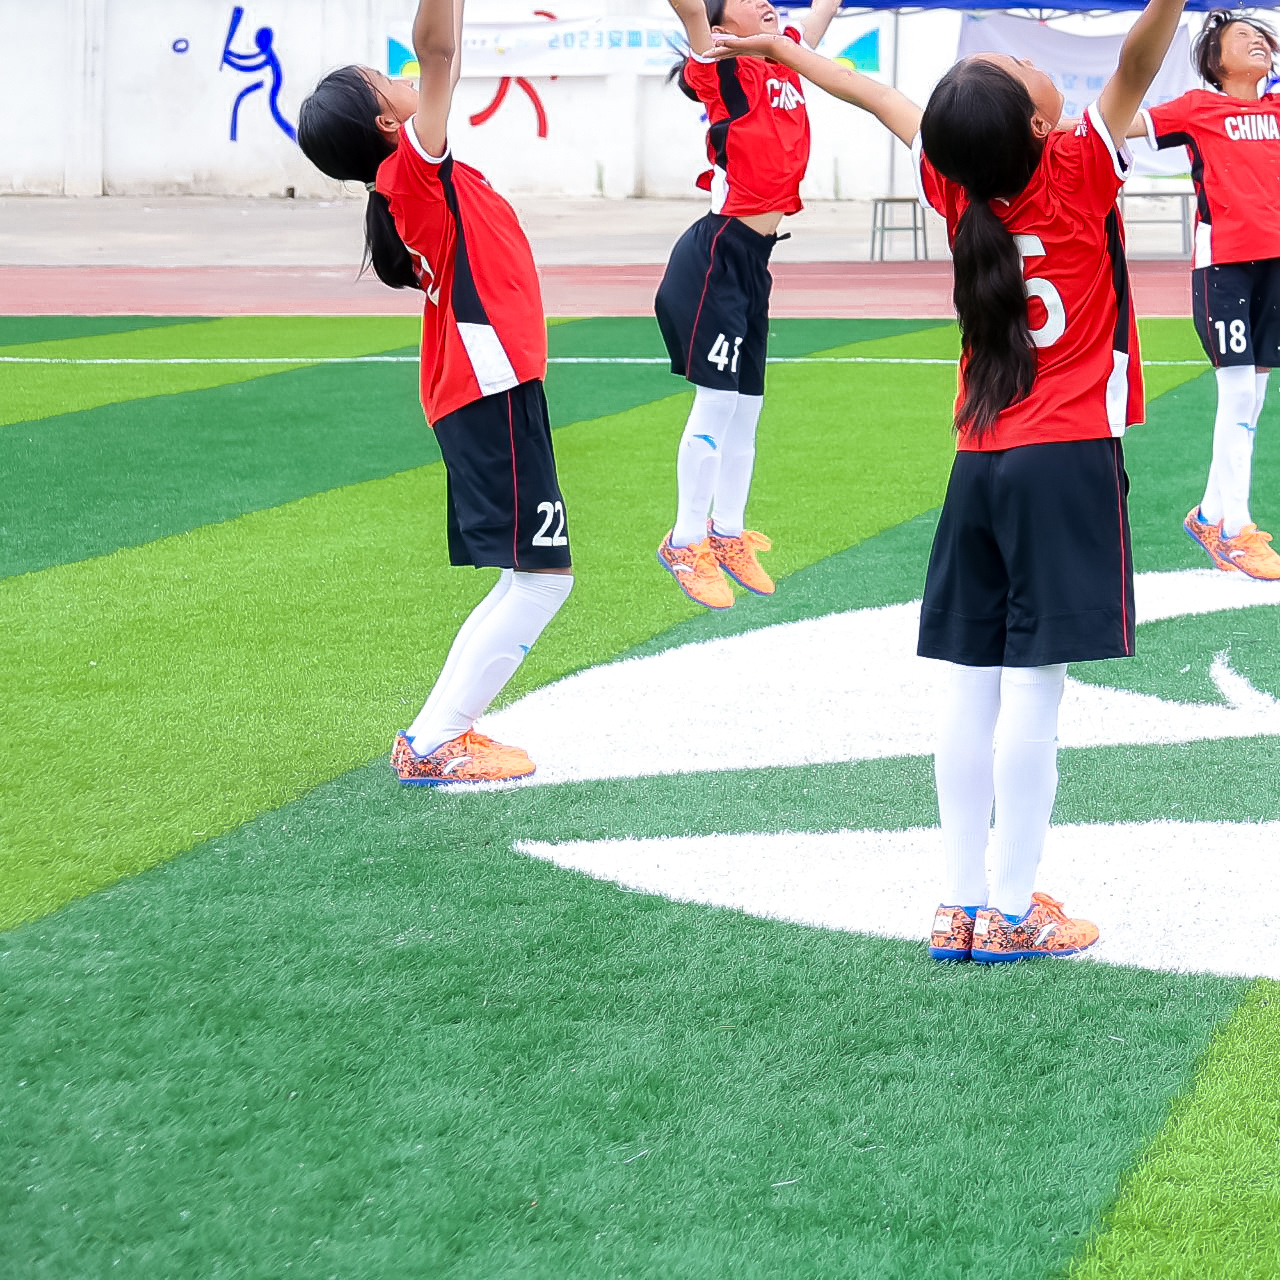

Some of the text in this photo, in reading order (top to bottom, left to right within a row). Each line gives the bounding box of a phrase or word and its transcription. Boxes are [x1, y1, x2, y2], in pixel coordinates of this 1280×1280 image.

[1224, 114, 1280, 141] CHINA
[707, 332, 743, 372] 41
[1214, 319, 1247, 354] 18
[532, 501, 567, 547] 22
